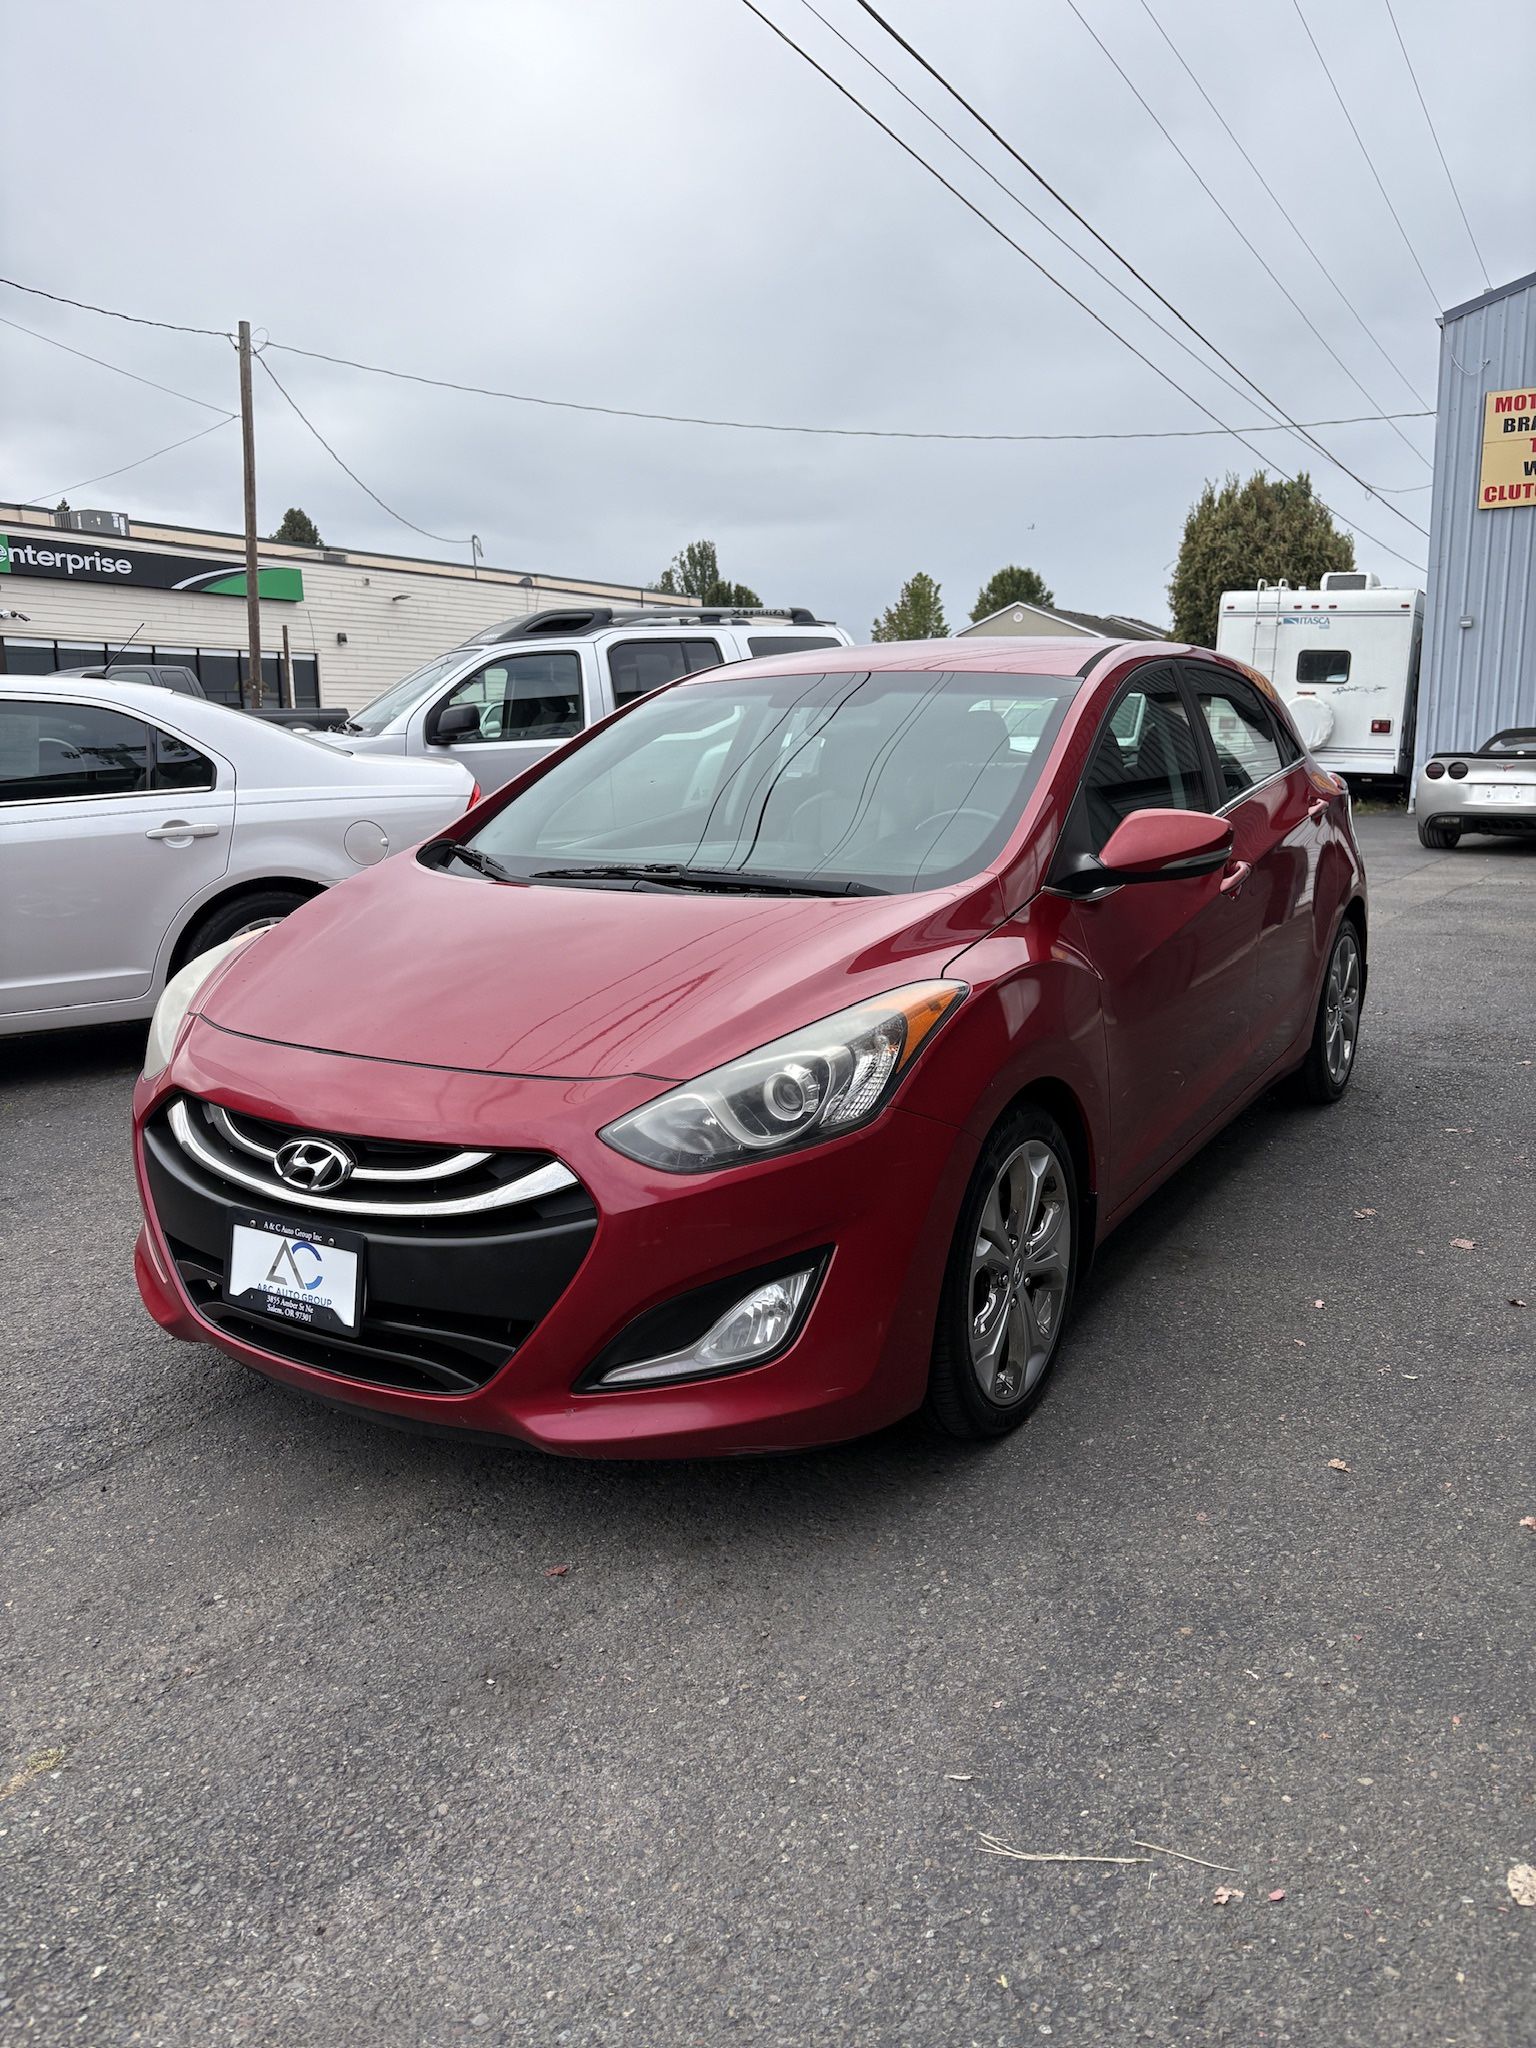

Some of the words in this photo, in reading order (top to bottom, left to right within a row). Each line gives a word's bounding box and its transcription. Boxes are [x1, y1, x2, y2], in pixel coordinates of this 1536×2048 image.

[1484, 483, 1536, 503] CLUT
[1300, 616, 1330, 625] ITASCA
[281, 1225, 294, 1235] Auto
[295, 1228, 312, 1241] Group
[313, 1231, 322, 1242] Inc
[266, 1294, 280, 1305] 3855
[280, 1298, 298, 1309] Amber
[276, 1287, 300, 1299] AUTO
[302, 1293, 332, 1307] GROUP
[284, 1308, 295, 1318] OR
[295, 1311, 312, 1323] 97301
